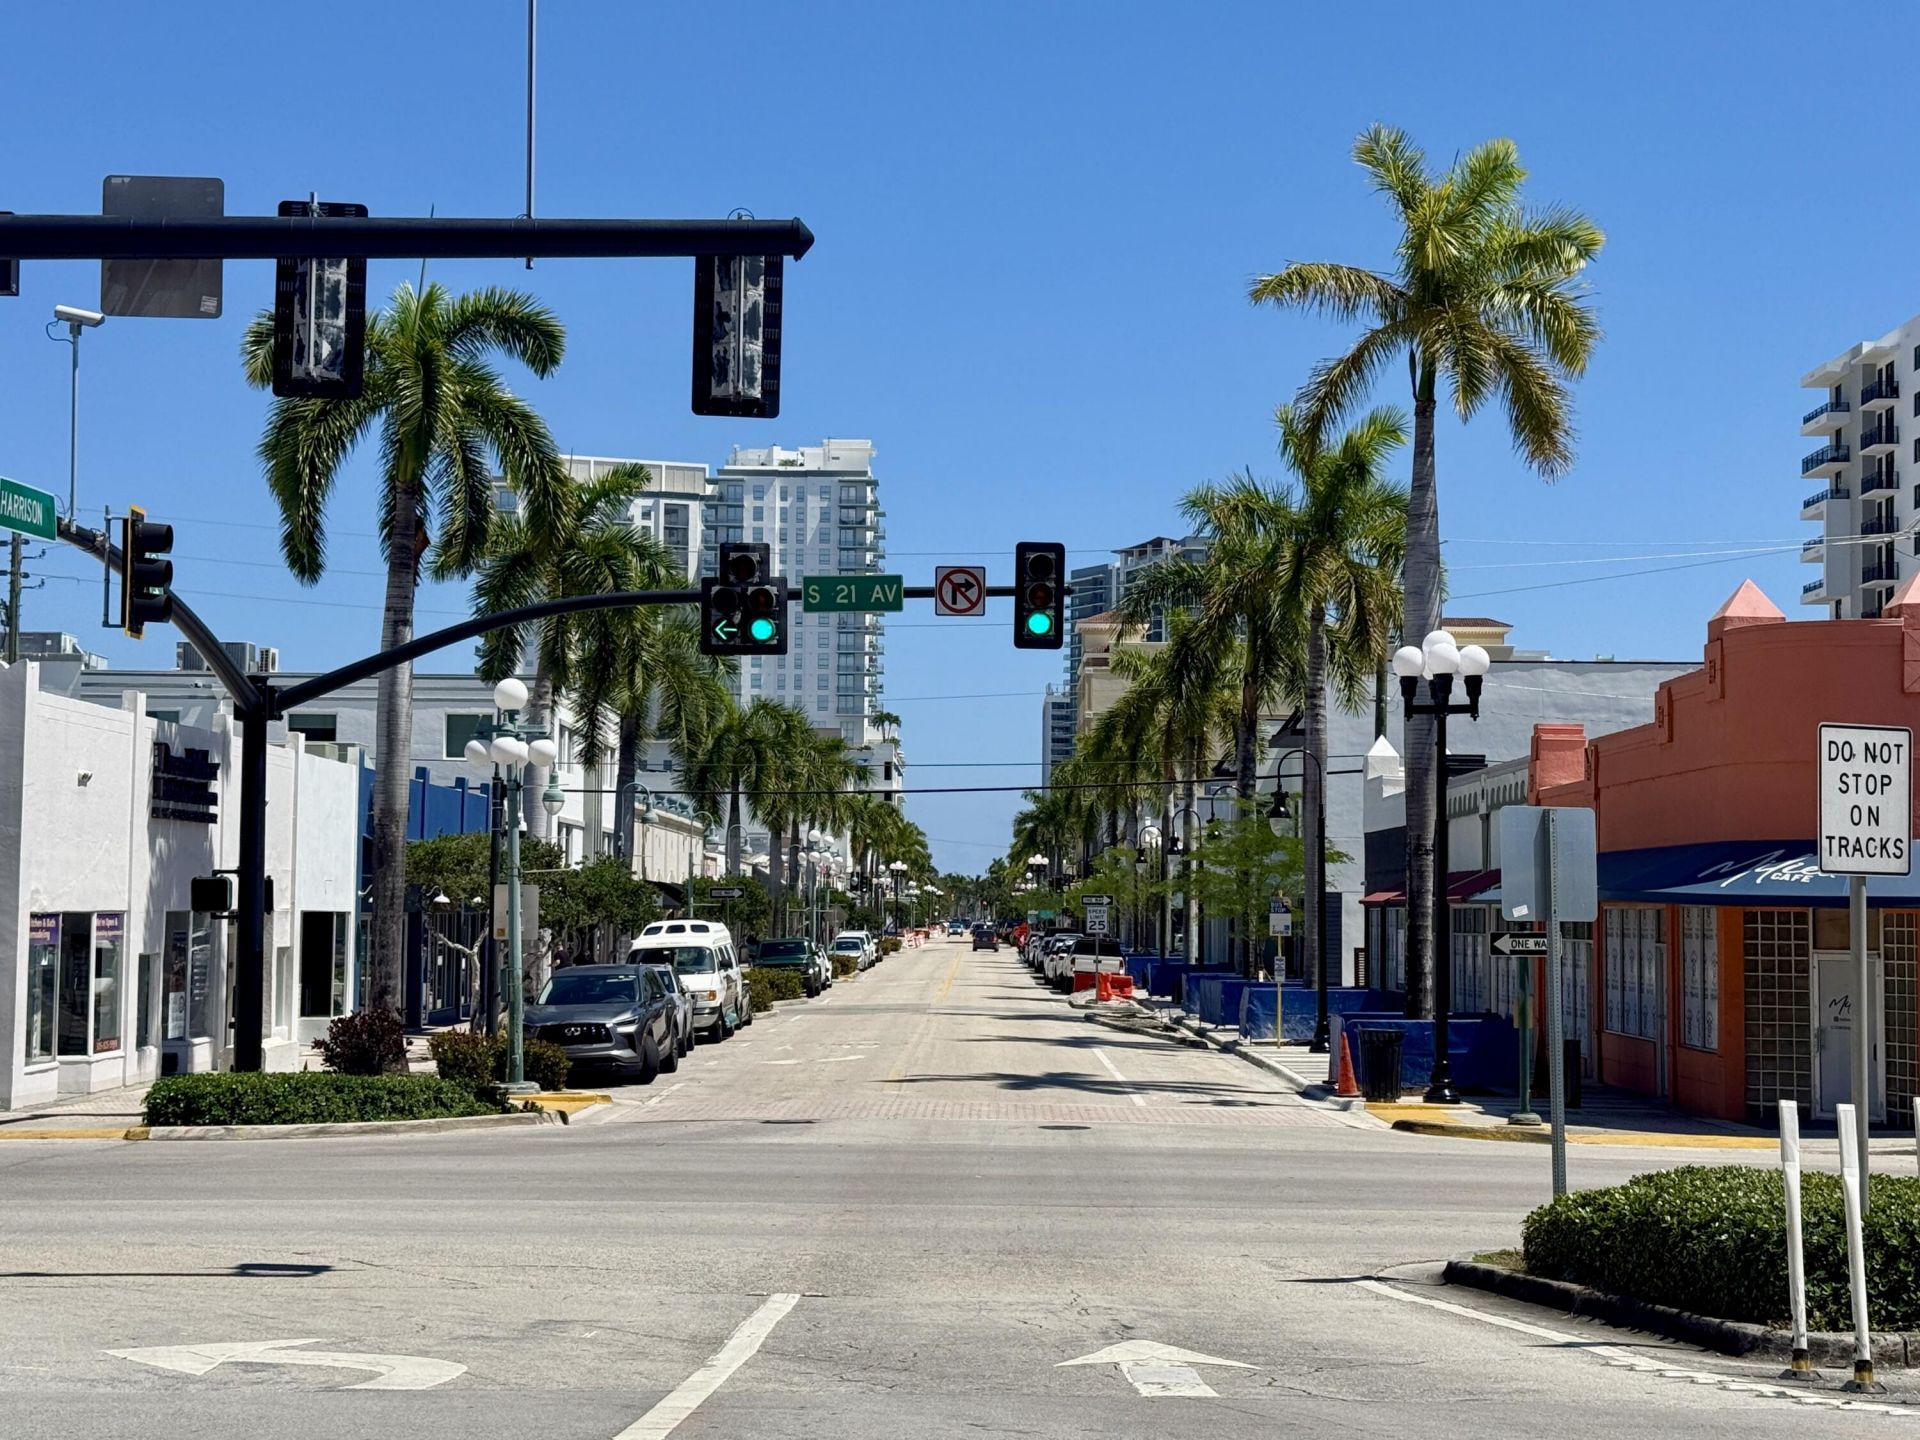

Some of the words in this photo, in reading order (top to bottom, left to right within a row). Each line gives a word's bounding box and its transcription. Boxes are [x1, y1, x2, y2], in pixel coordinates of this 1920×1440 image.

[0, 490, 43, 527] HARRISON
[808, 584, 820, 604] S
[836, 584, 856, 603] 21
[870, 584, 897, 603] AV
[1828, 740, 1853, 762] DO
[1864, 742, 1903, 764] NOT
[1838, 772, 1892, 795] STOP
[1850, 804, 1880, 827] ON
[1825, 835, 1904, 859] TRACKS
[1770, 872, 1814, 883] CAFE
[1089, 920, 1106, 930] 25
[1511, 939, 1529, 949] ONE
[1534, 939, 1548, 949] WA
